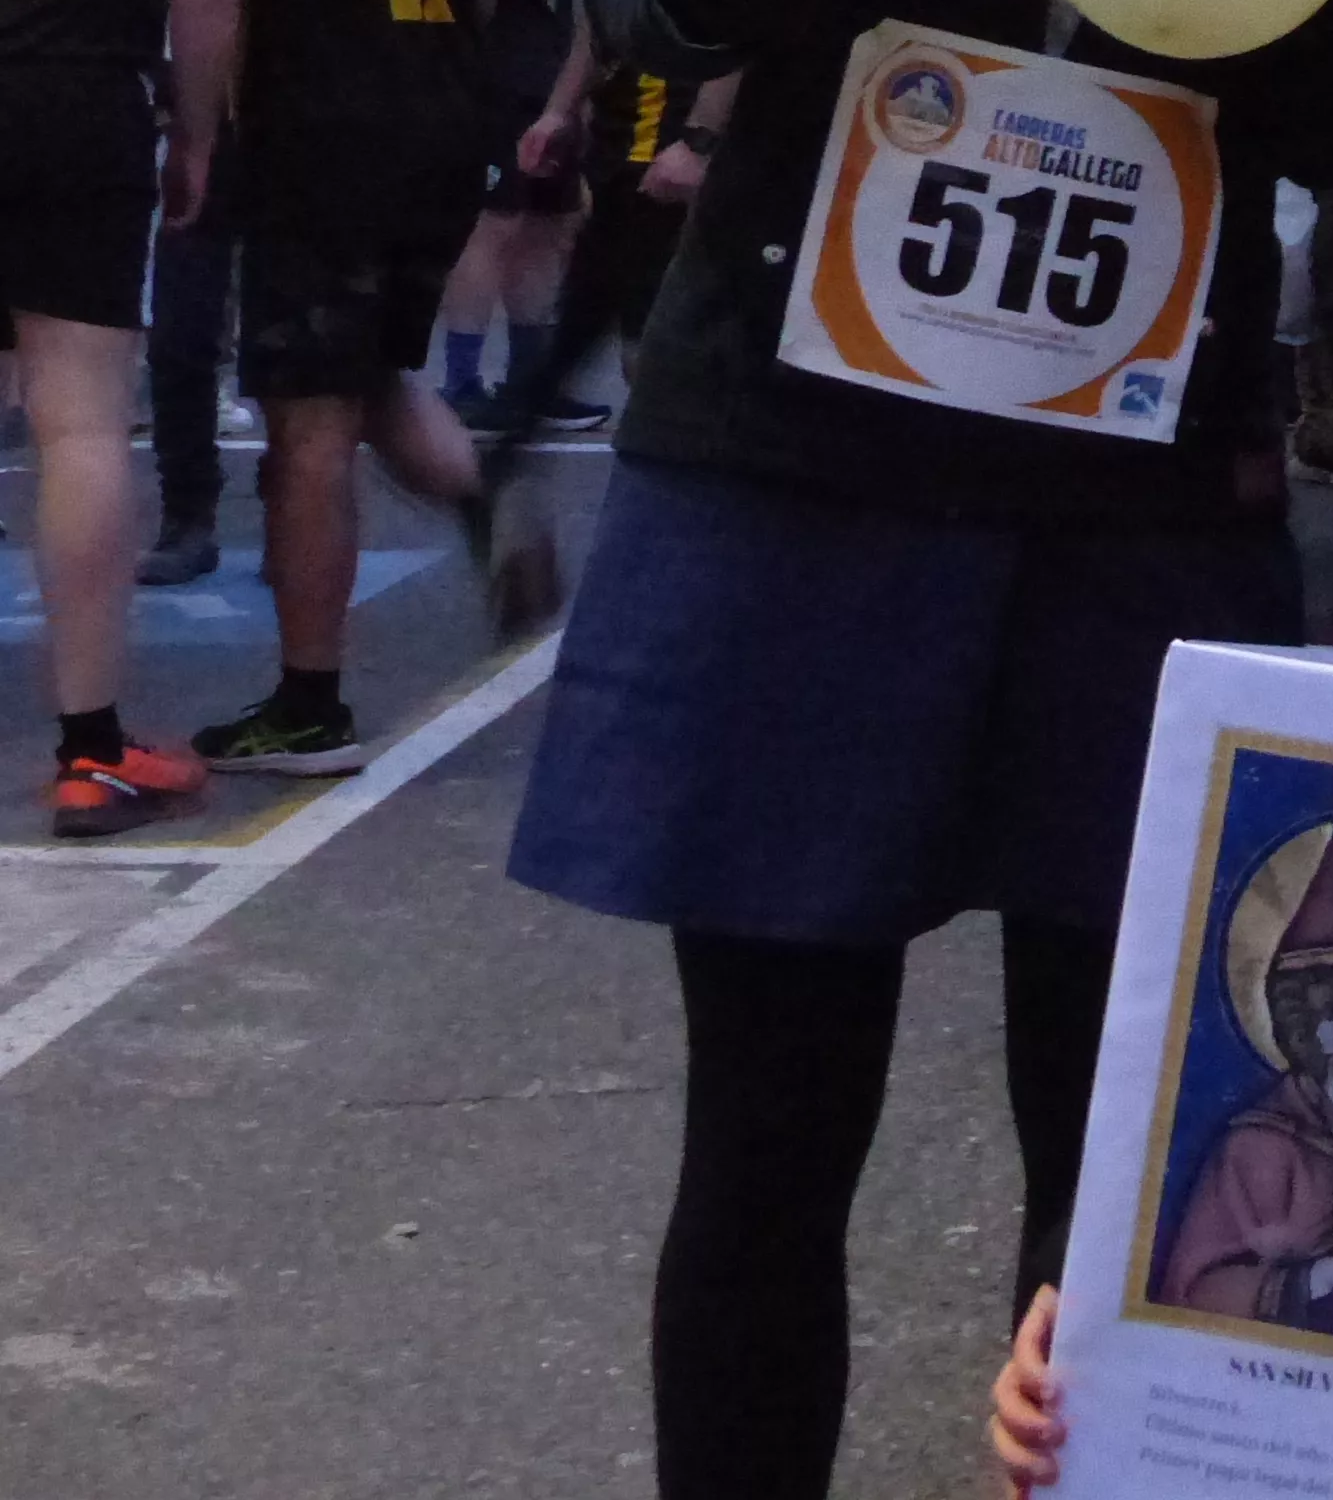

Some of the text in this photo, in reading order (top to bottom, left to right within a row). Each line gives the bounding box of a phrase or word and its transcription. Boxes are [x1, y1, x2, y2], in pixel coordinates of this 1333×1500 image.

[993, 109, 1087, 150] CARRERAS
[898, 160, 1137, 328] 515
[1229, 1357, 1274, 1382] SAN
